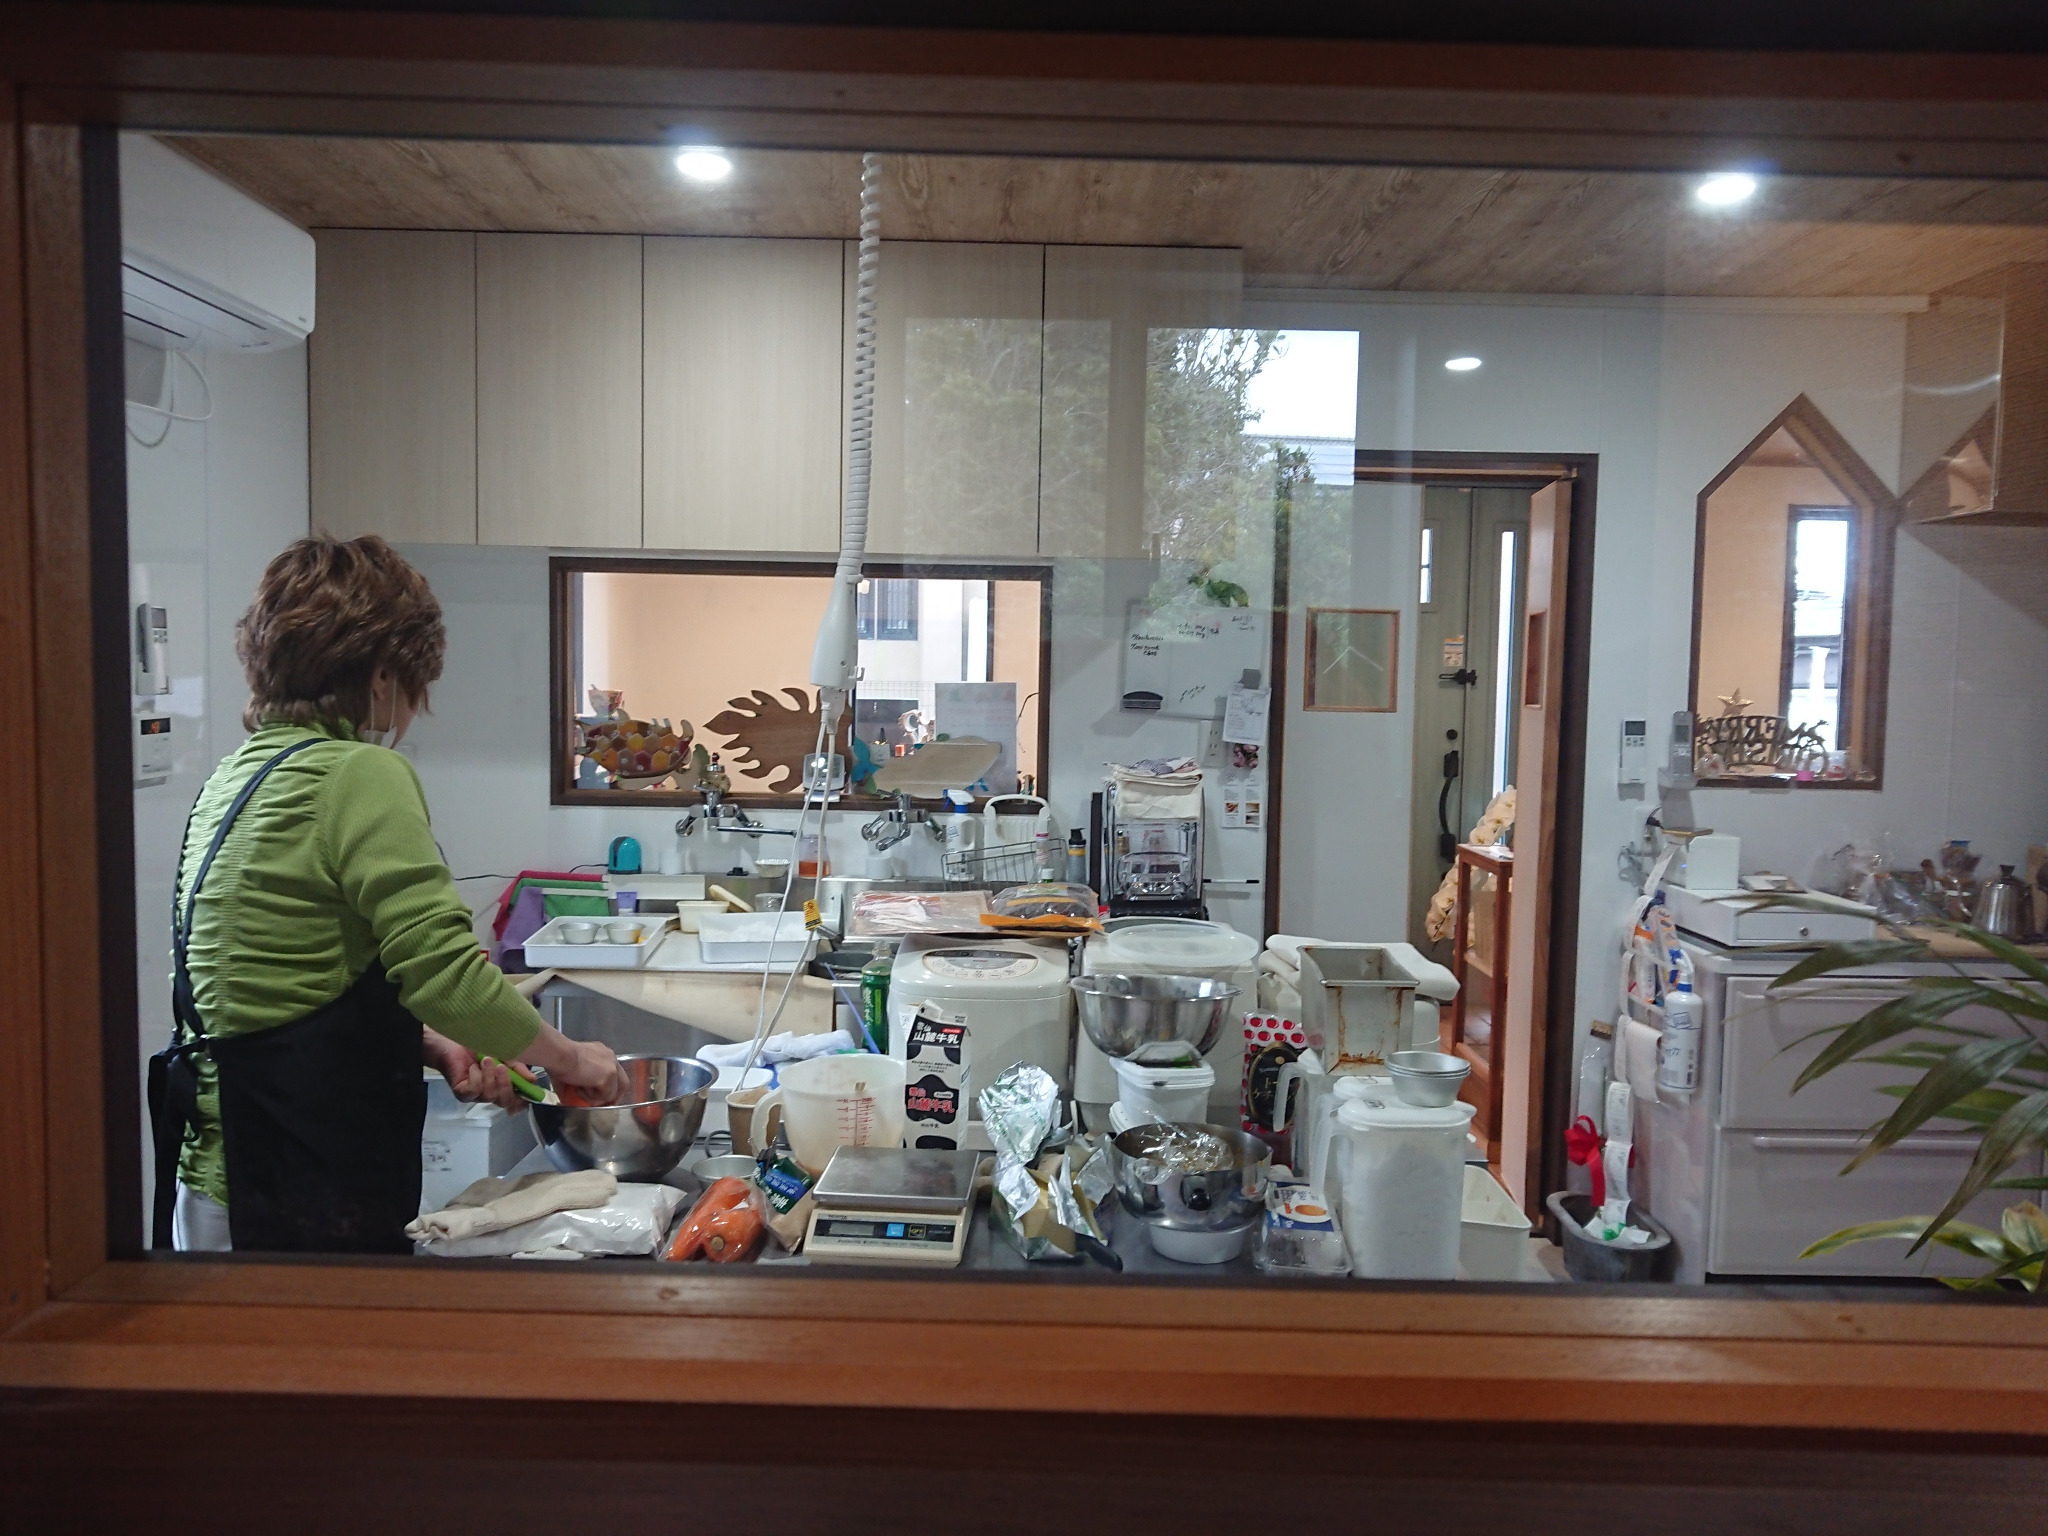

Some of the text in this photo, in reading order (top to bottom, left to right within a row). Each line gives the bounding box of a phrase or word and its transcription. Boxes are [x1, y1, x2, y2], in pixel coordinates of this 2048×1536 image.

[913, 1031, 959, 1044] 山麓牛乳
[907, 1097, 955, 1113] 山麓牛乳
